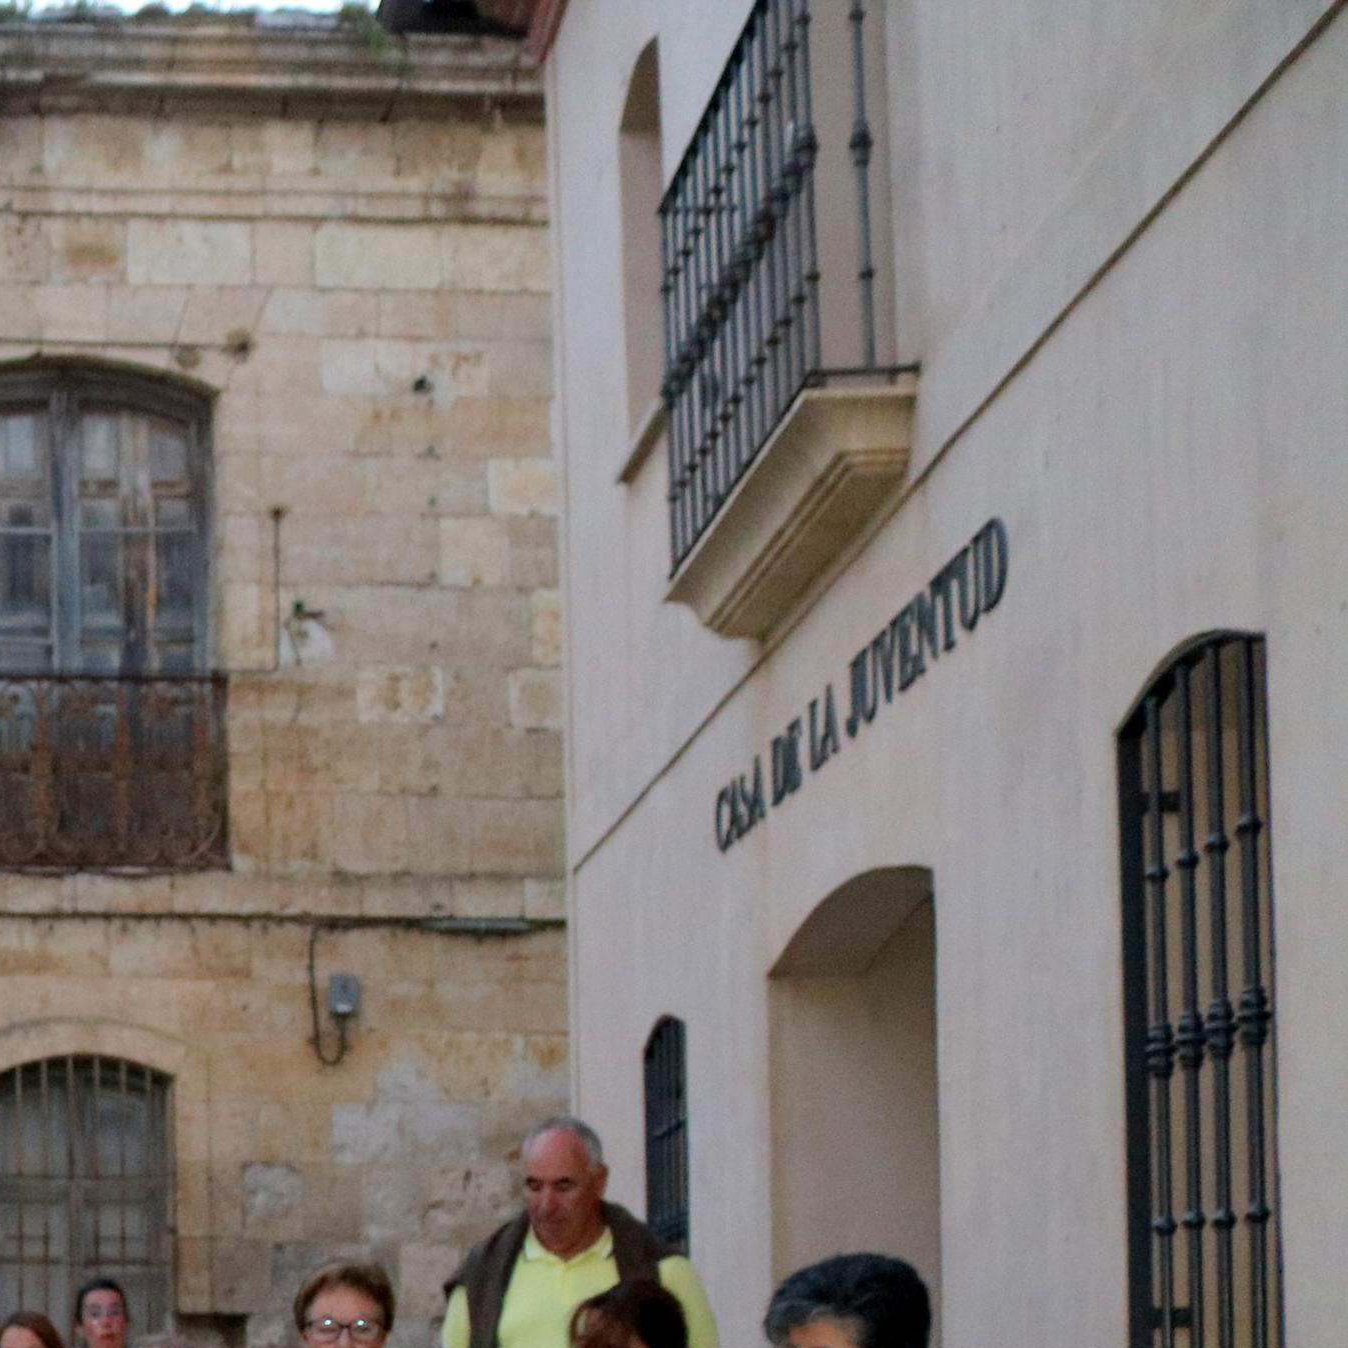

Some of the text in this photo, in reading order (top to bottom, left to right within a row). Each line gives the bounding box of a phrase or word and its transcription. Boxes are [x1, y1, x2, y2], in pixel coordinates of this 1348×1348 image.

[715, 516, 1009, 853] CASA DE LA JUVENTUD
